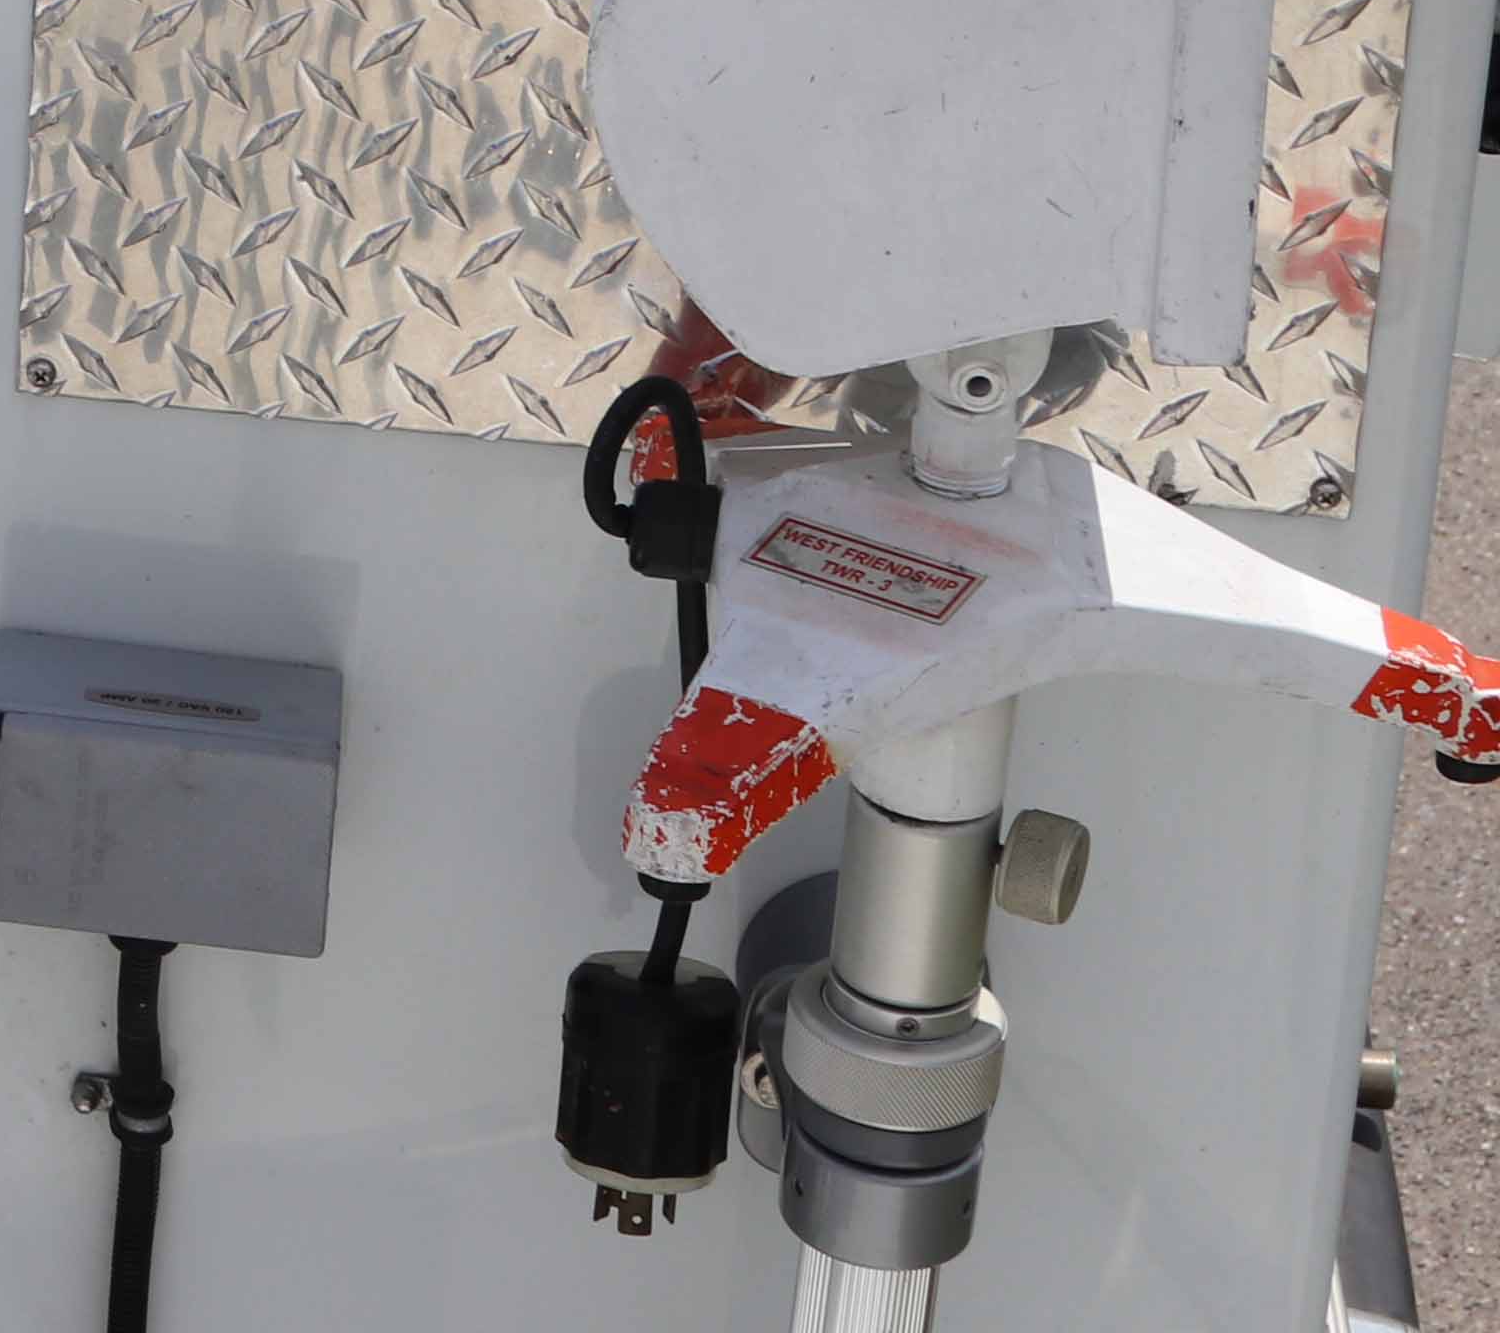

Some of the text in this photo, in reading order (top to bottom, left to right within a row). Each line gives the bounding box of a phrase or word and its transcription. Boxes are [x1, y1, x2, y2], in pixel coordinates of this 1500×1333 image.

[783, 528, 960, 592] WEST FRIENDSHIP
[820, 560, 865, 584] TWR
[877, 580, 894, 592] 3
